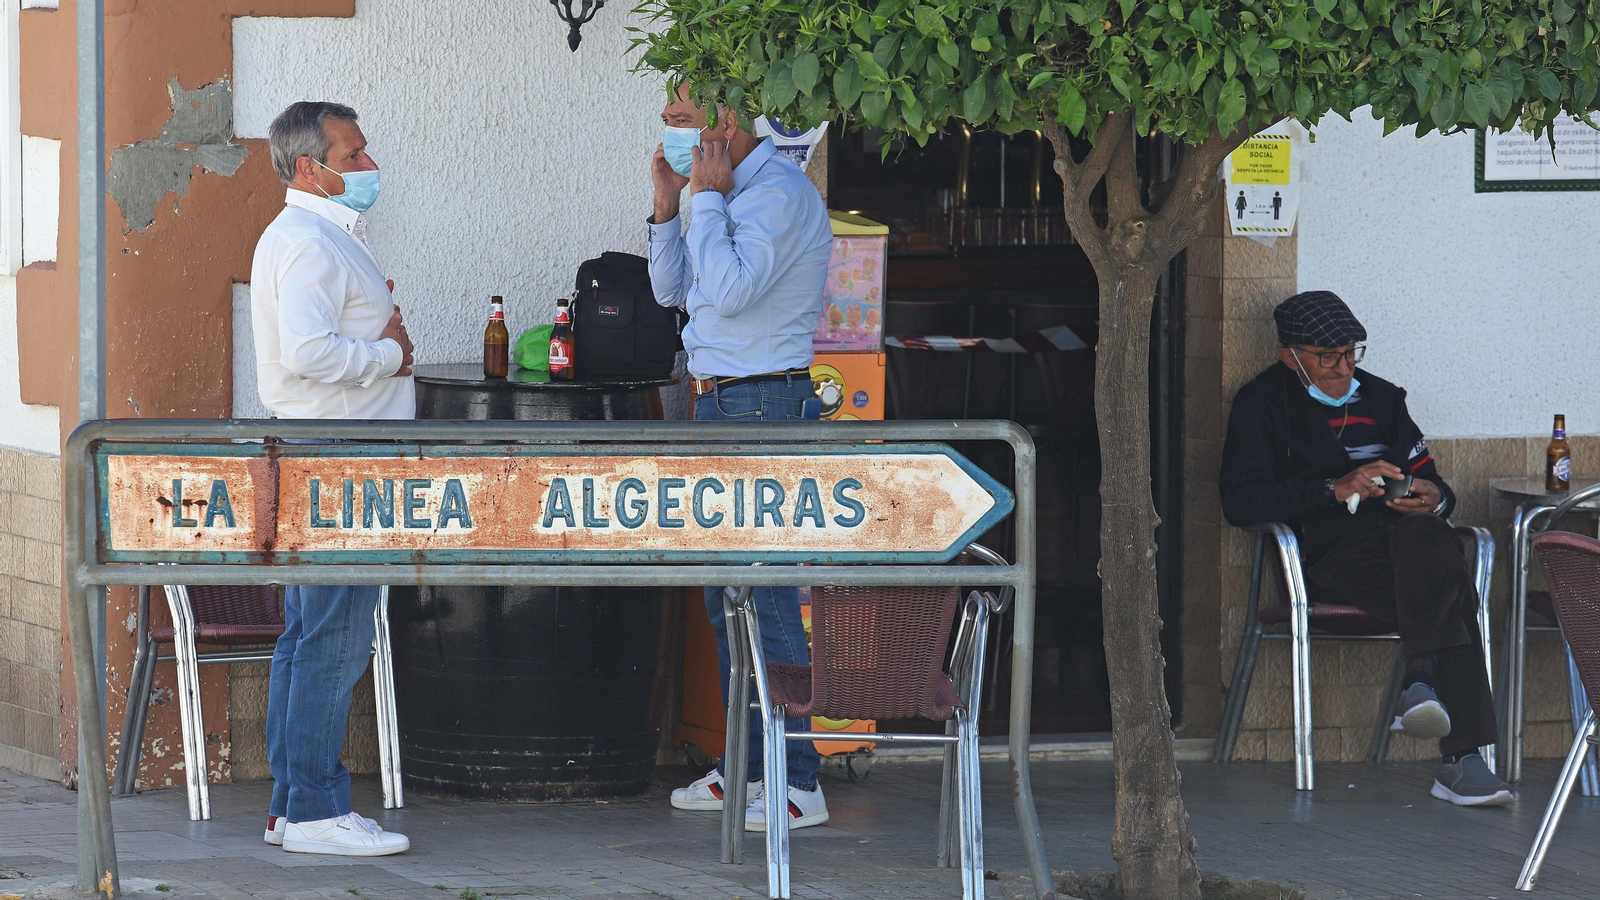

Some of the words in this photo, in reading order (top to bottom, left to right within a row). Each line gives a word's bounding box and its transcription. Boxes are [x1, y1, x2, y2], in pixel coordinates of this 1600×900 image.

[172, 478, 237, 528] LA
[310, 478, 473, 529] LINEA
[541, 477, 866, 529] ALGECIRAS
